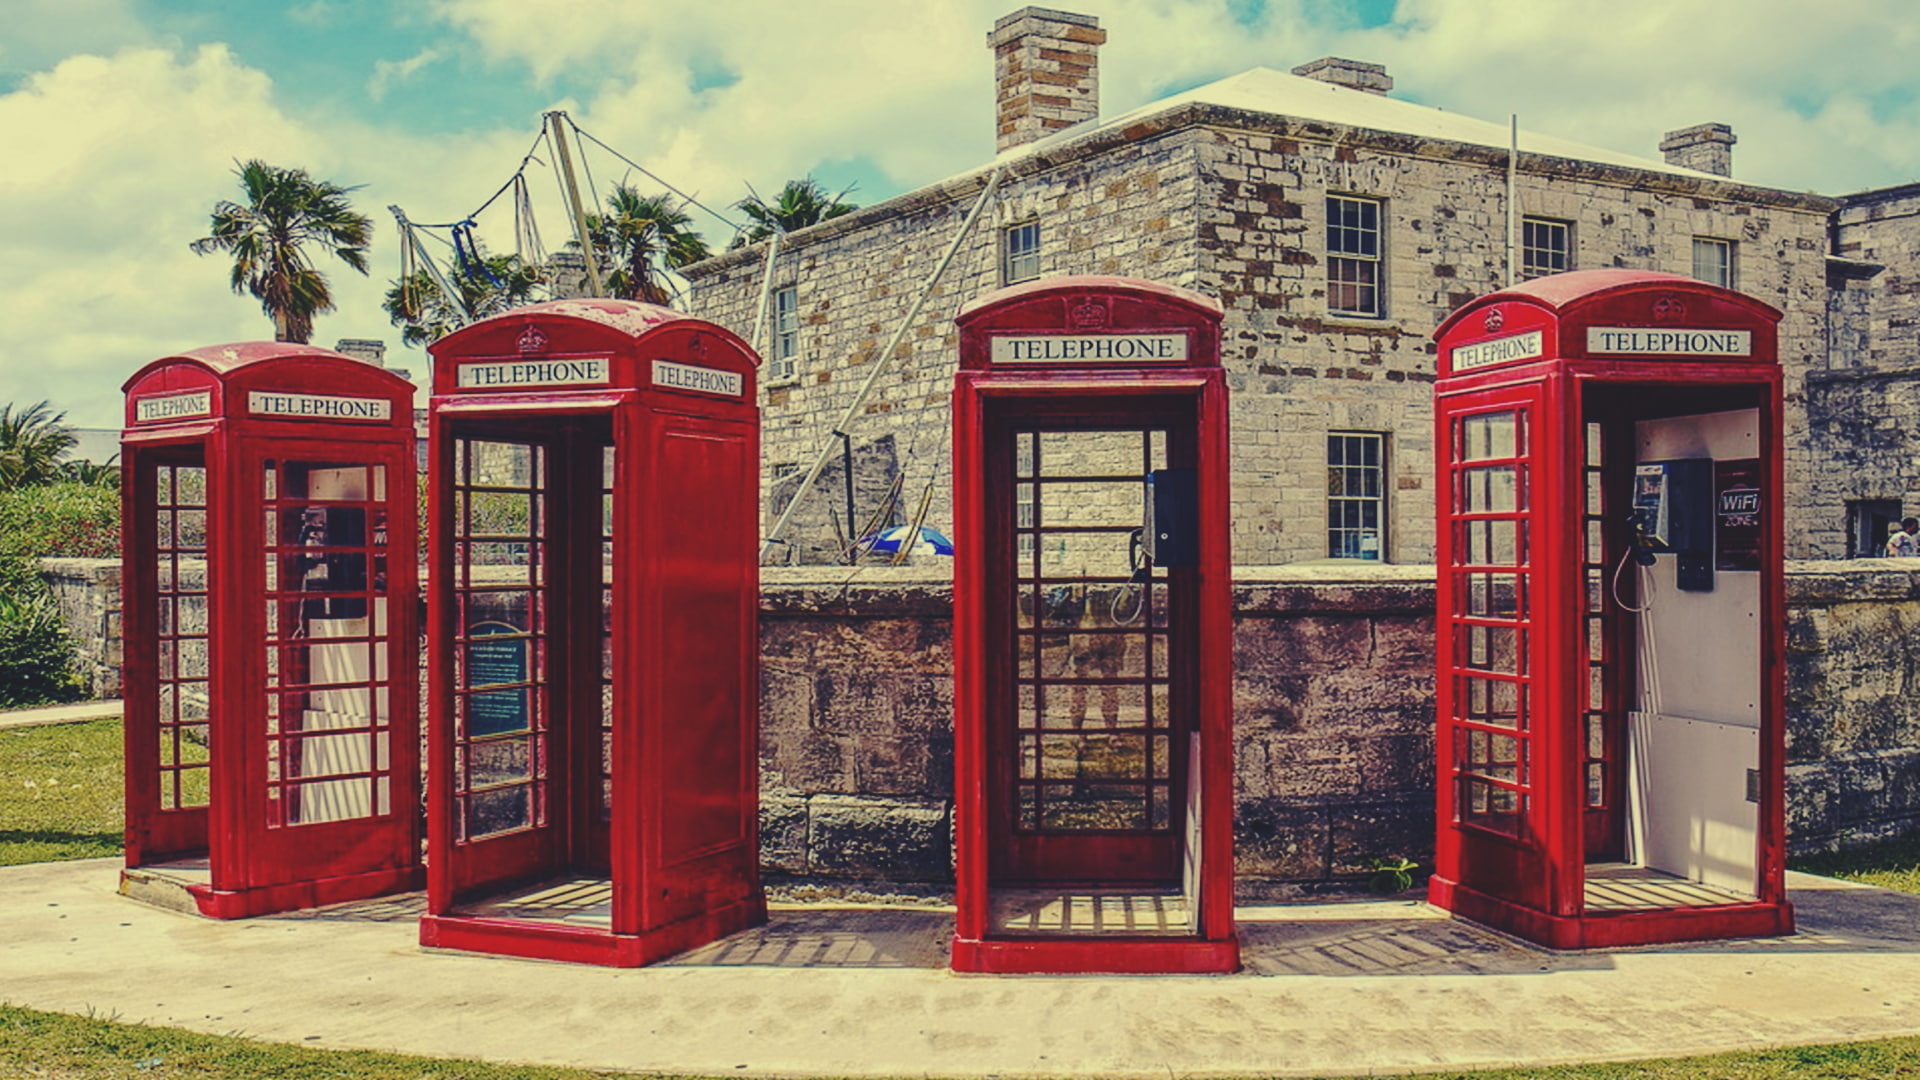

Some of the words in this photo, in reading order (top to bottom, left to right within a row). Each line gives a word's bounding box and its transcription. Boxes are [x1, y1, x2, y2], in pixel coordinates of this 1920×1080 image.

[1008, 339, 1174, 359] TELEPHONE
[1460, 336, 1536, 367] TELEPHONE
[1600, 332, 1740, 352] TELEPHONE
[471, 361, 600, 385] TELEPHONE
[658, 366, 737, 392] TELEPHONE
[143, 397, 206, 418] TELEPHONE
[260, 396, 380, 417] TELEPHONE
[1723, 494, 1757, 511] WiFi
